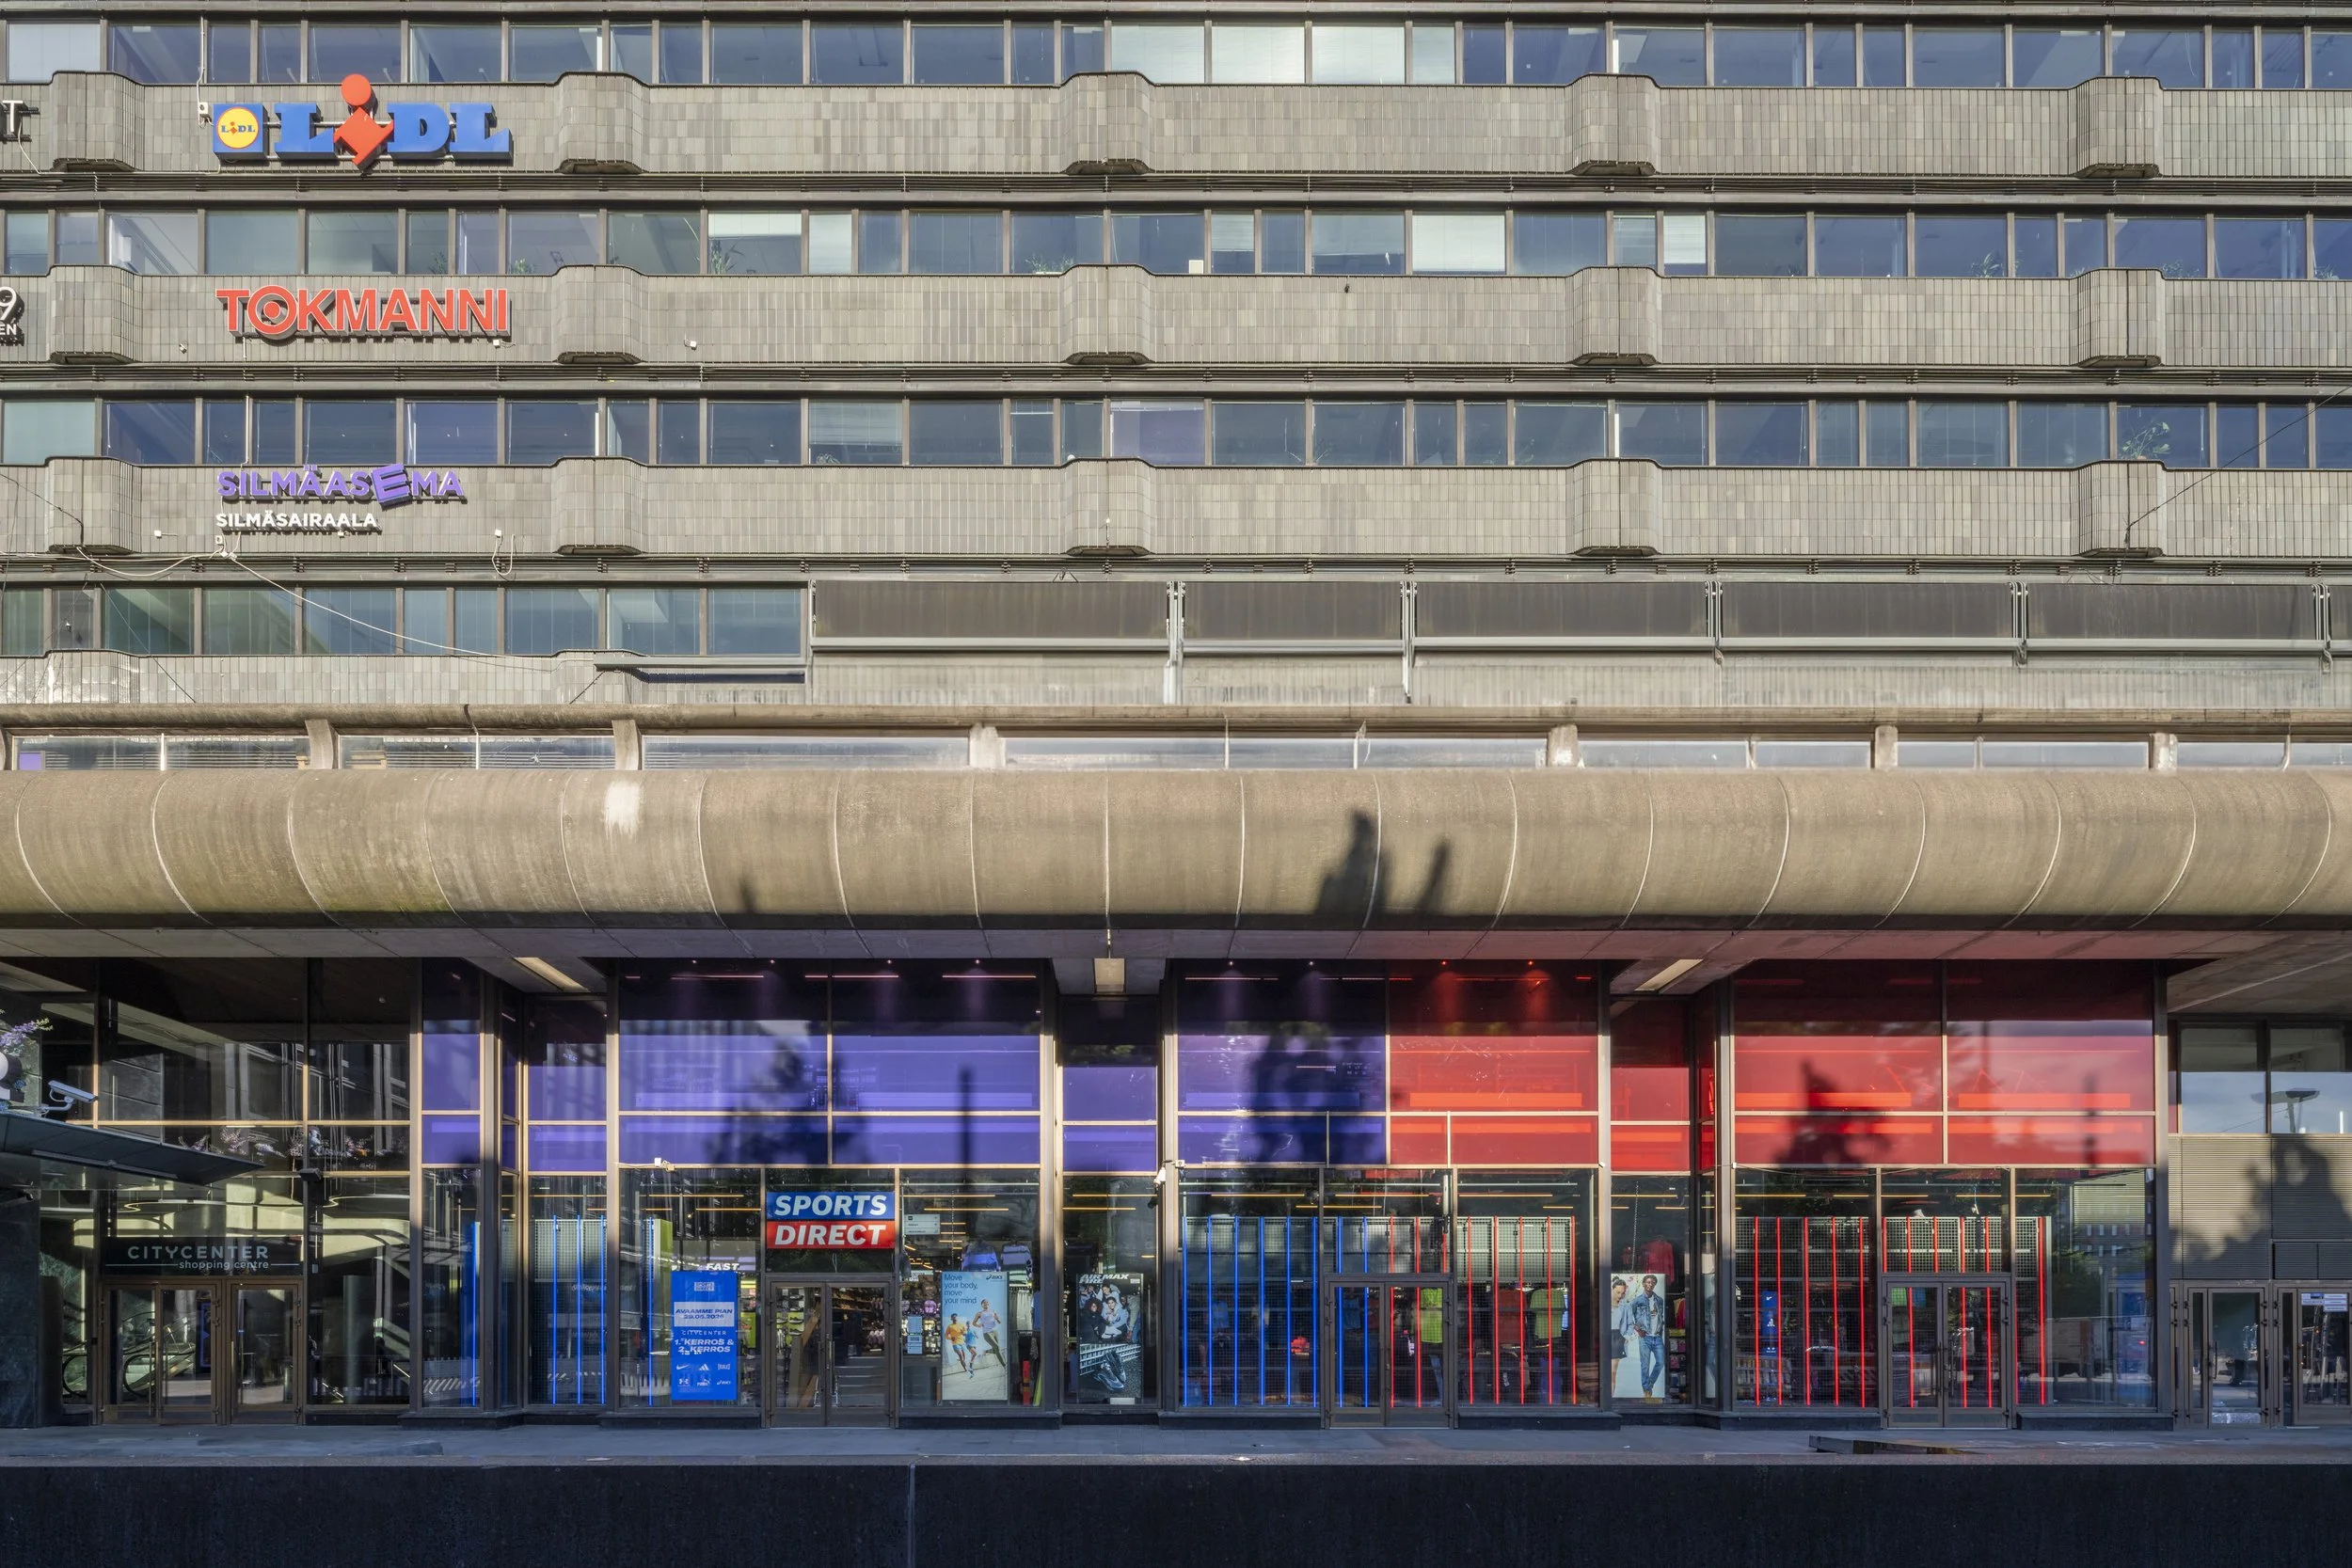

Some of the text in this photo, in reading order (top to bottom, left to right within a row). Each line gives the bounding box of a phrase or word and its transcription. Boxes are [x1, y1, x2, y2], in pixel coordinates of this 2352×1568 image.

[215, 285, 508, 334] TOKMANNI
[217, 464, 464, 502] SILMÄASEMA
[215, 510, 378, 528] SILMÄSAIRAALA
[774, 1195, 887, 1216] SPORTS
[774, 1225, 887, 1245] DIRECT
[127, 1245, 269, 1259] CITYCENTER
[179, 1259, 269, 1270] shopping centre
[706, 1262, 739, 1271] FAST
